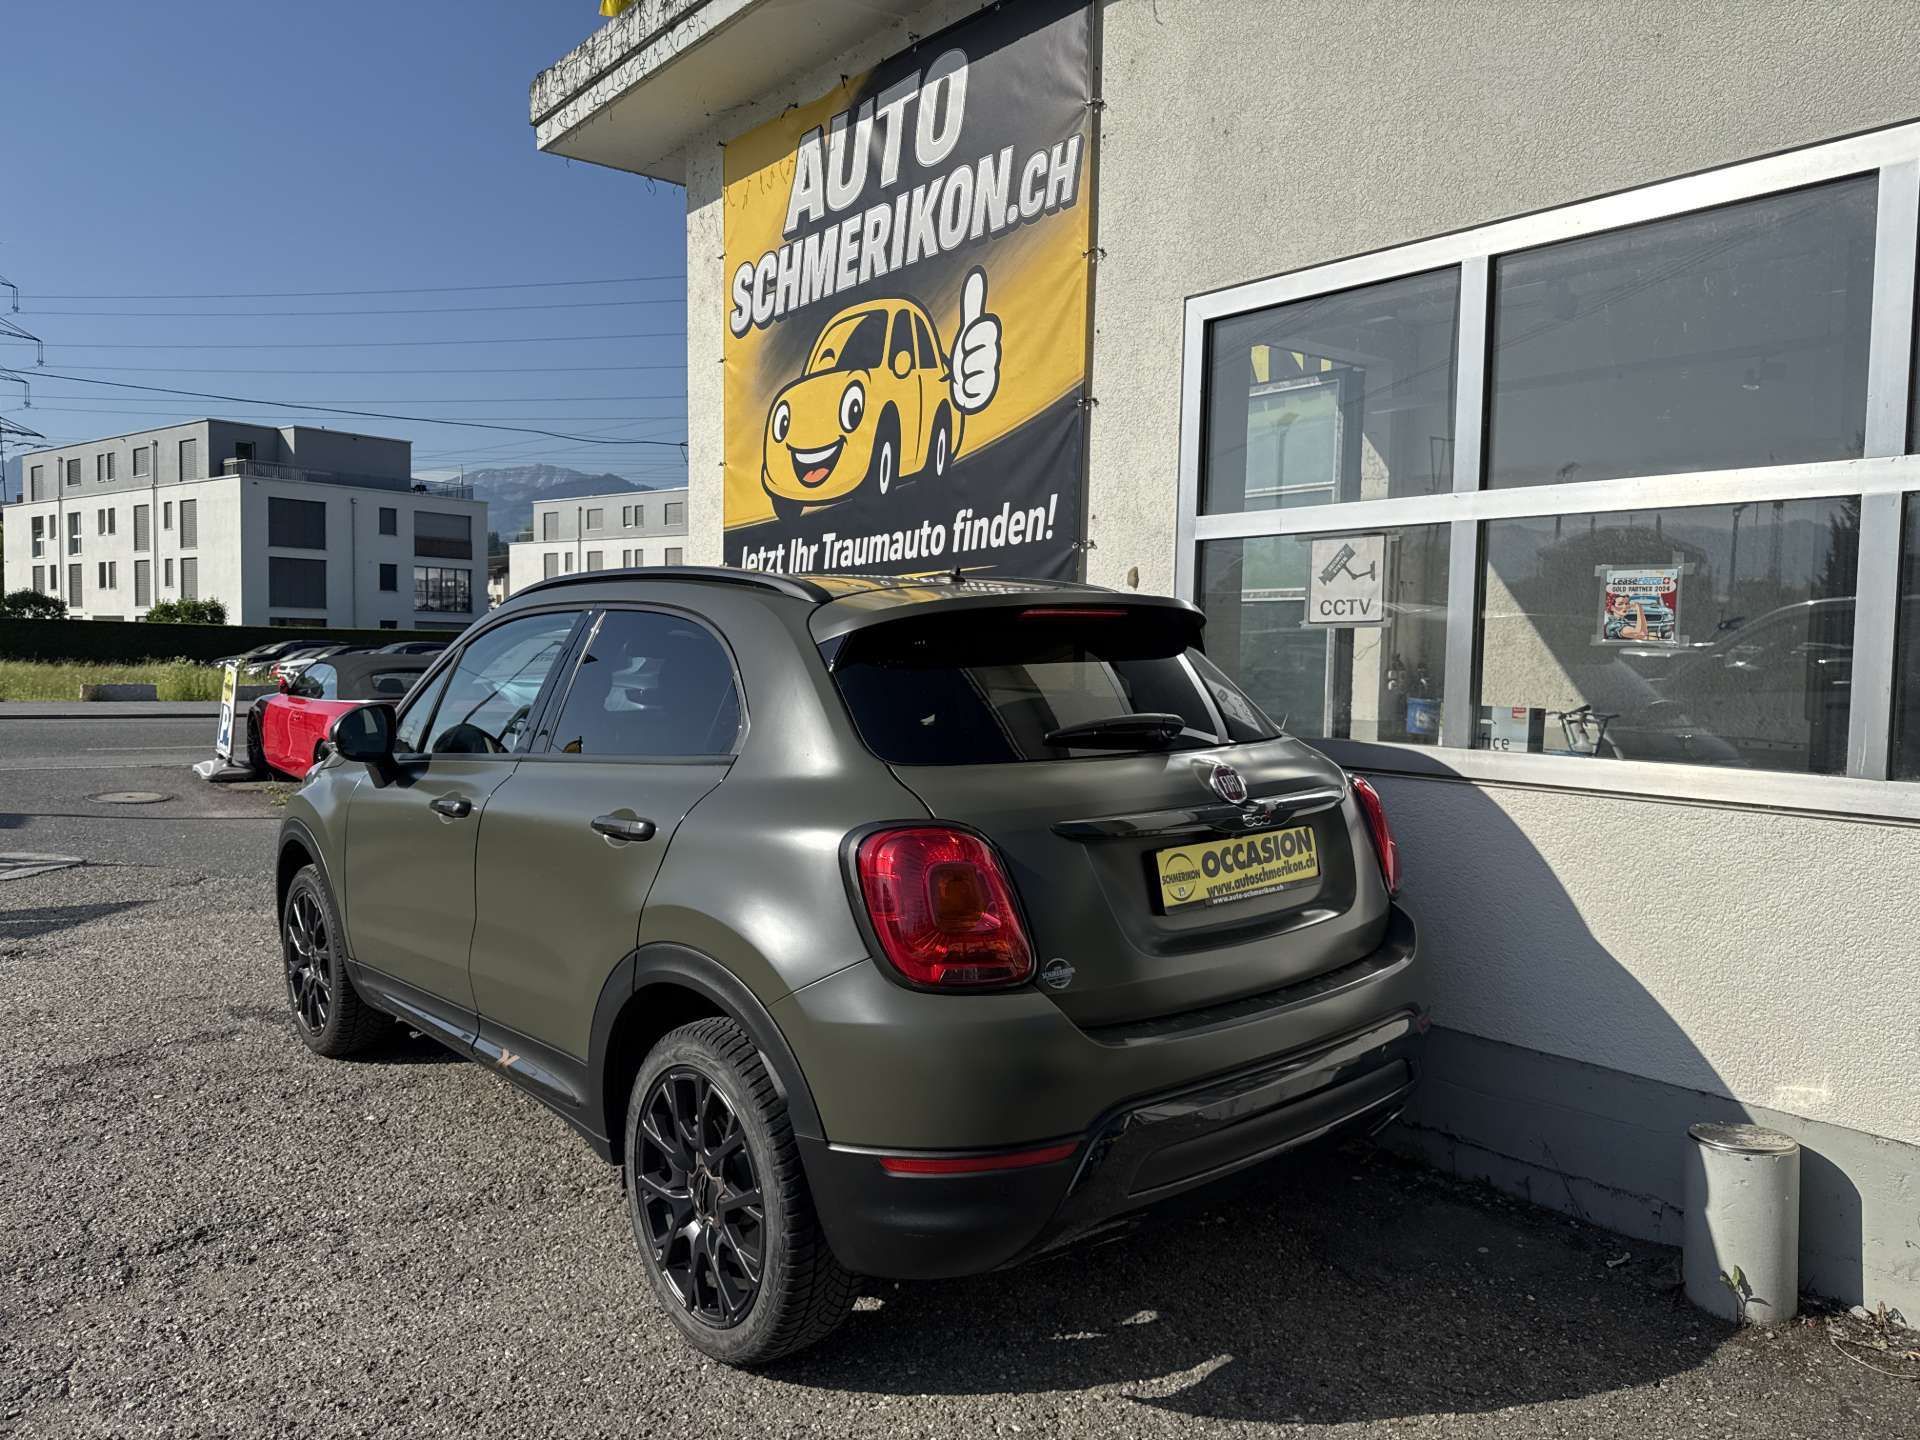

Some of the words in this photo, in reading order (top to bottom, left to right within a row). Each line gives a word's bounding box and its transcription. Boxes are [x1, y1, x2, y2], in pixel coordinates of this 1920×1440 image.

[783, 48, 968, 233] AUTO
[730, 134, 1083, 335] SCHMERIKON.CH
[741, 543, 786, 574] Jetzt
[789, 537, 818, 574] Ihr
[822, 520, 945, 570] Traumauto
[952, 494, 1058, 553] finden!
[1320, 598, 1372, 616] CCTV
[1219, 774, 1241, 794] FIAT
[1201, 827, 1313, 878] OCCASION
[1206, 853, 1316, 898] www.autoschmerikon.ch
[1161, 869, 1201, 886] SCHMERIKON
